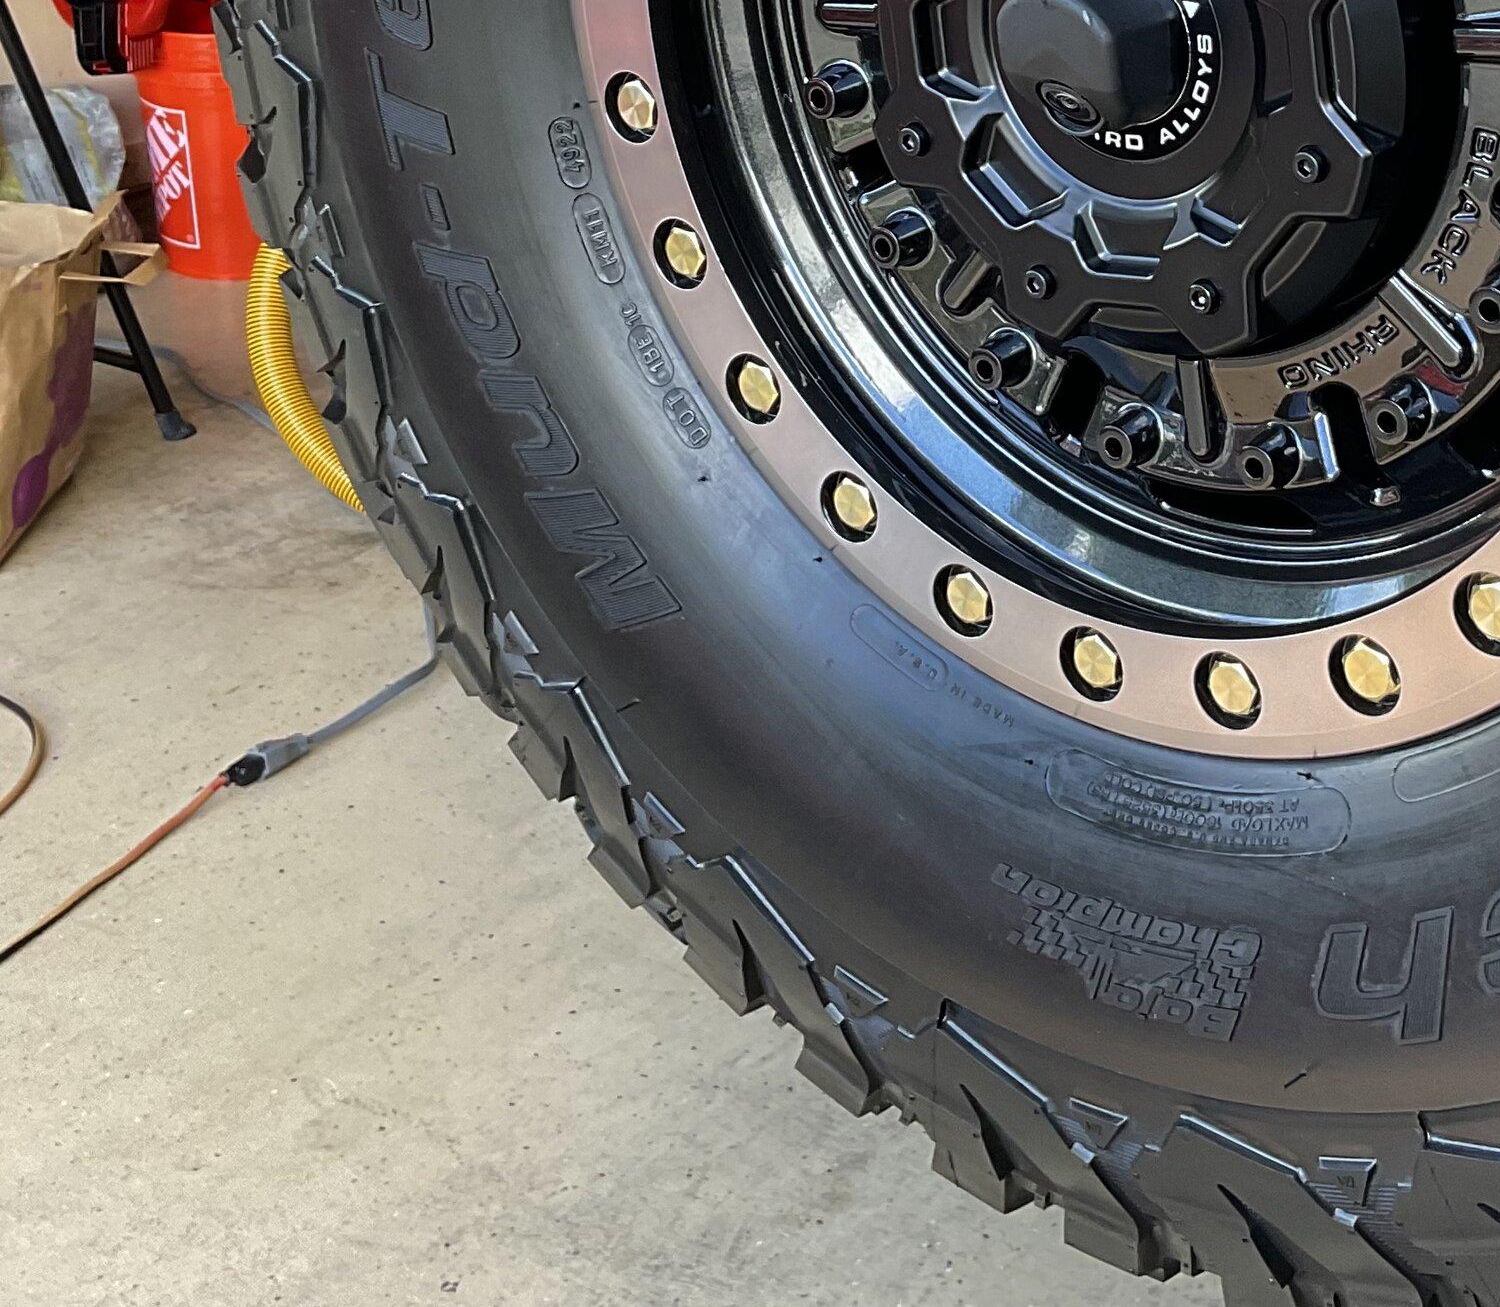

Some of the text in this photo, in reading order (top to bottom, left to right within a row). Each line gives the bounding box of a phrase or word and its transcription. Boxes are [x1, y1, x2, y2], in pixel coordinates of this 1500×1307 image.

[554, 117, 585, 173] 4922
[1094, 33, 1213, 152] RD ALLOYS
[1277, 126, 1500, 389] BLACK RHINO
[666, 393, 708, 447] DOT
[990, 861, 1264, 967] Champion
